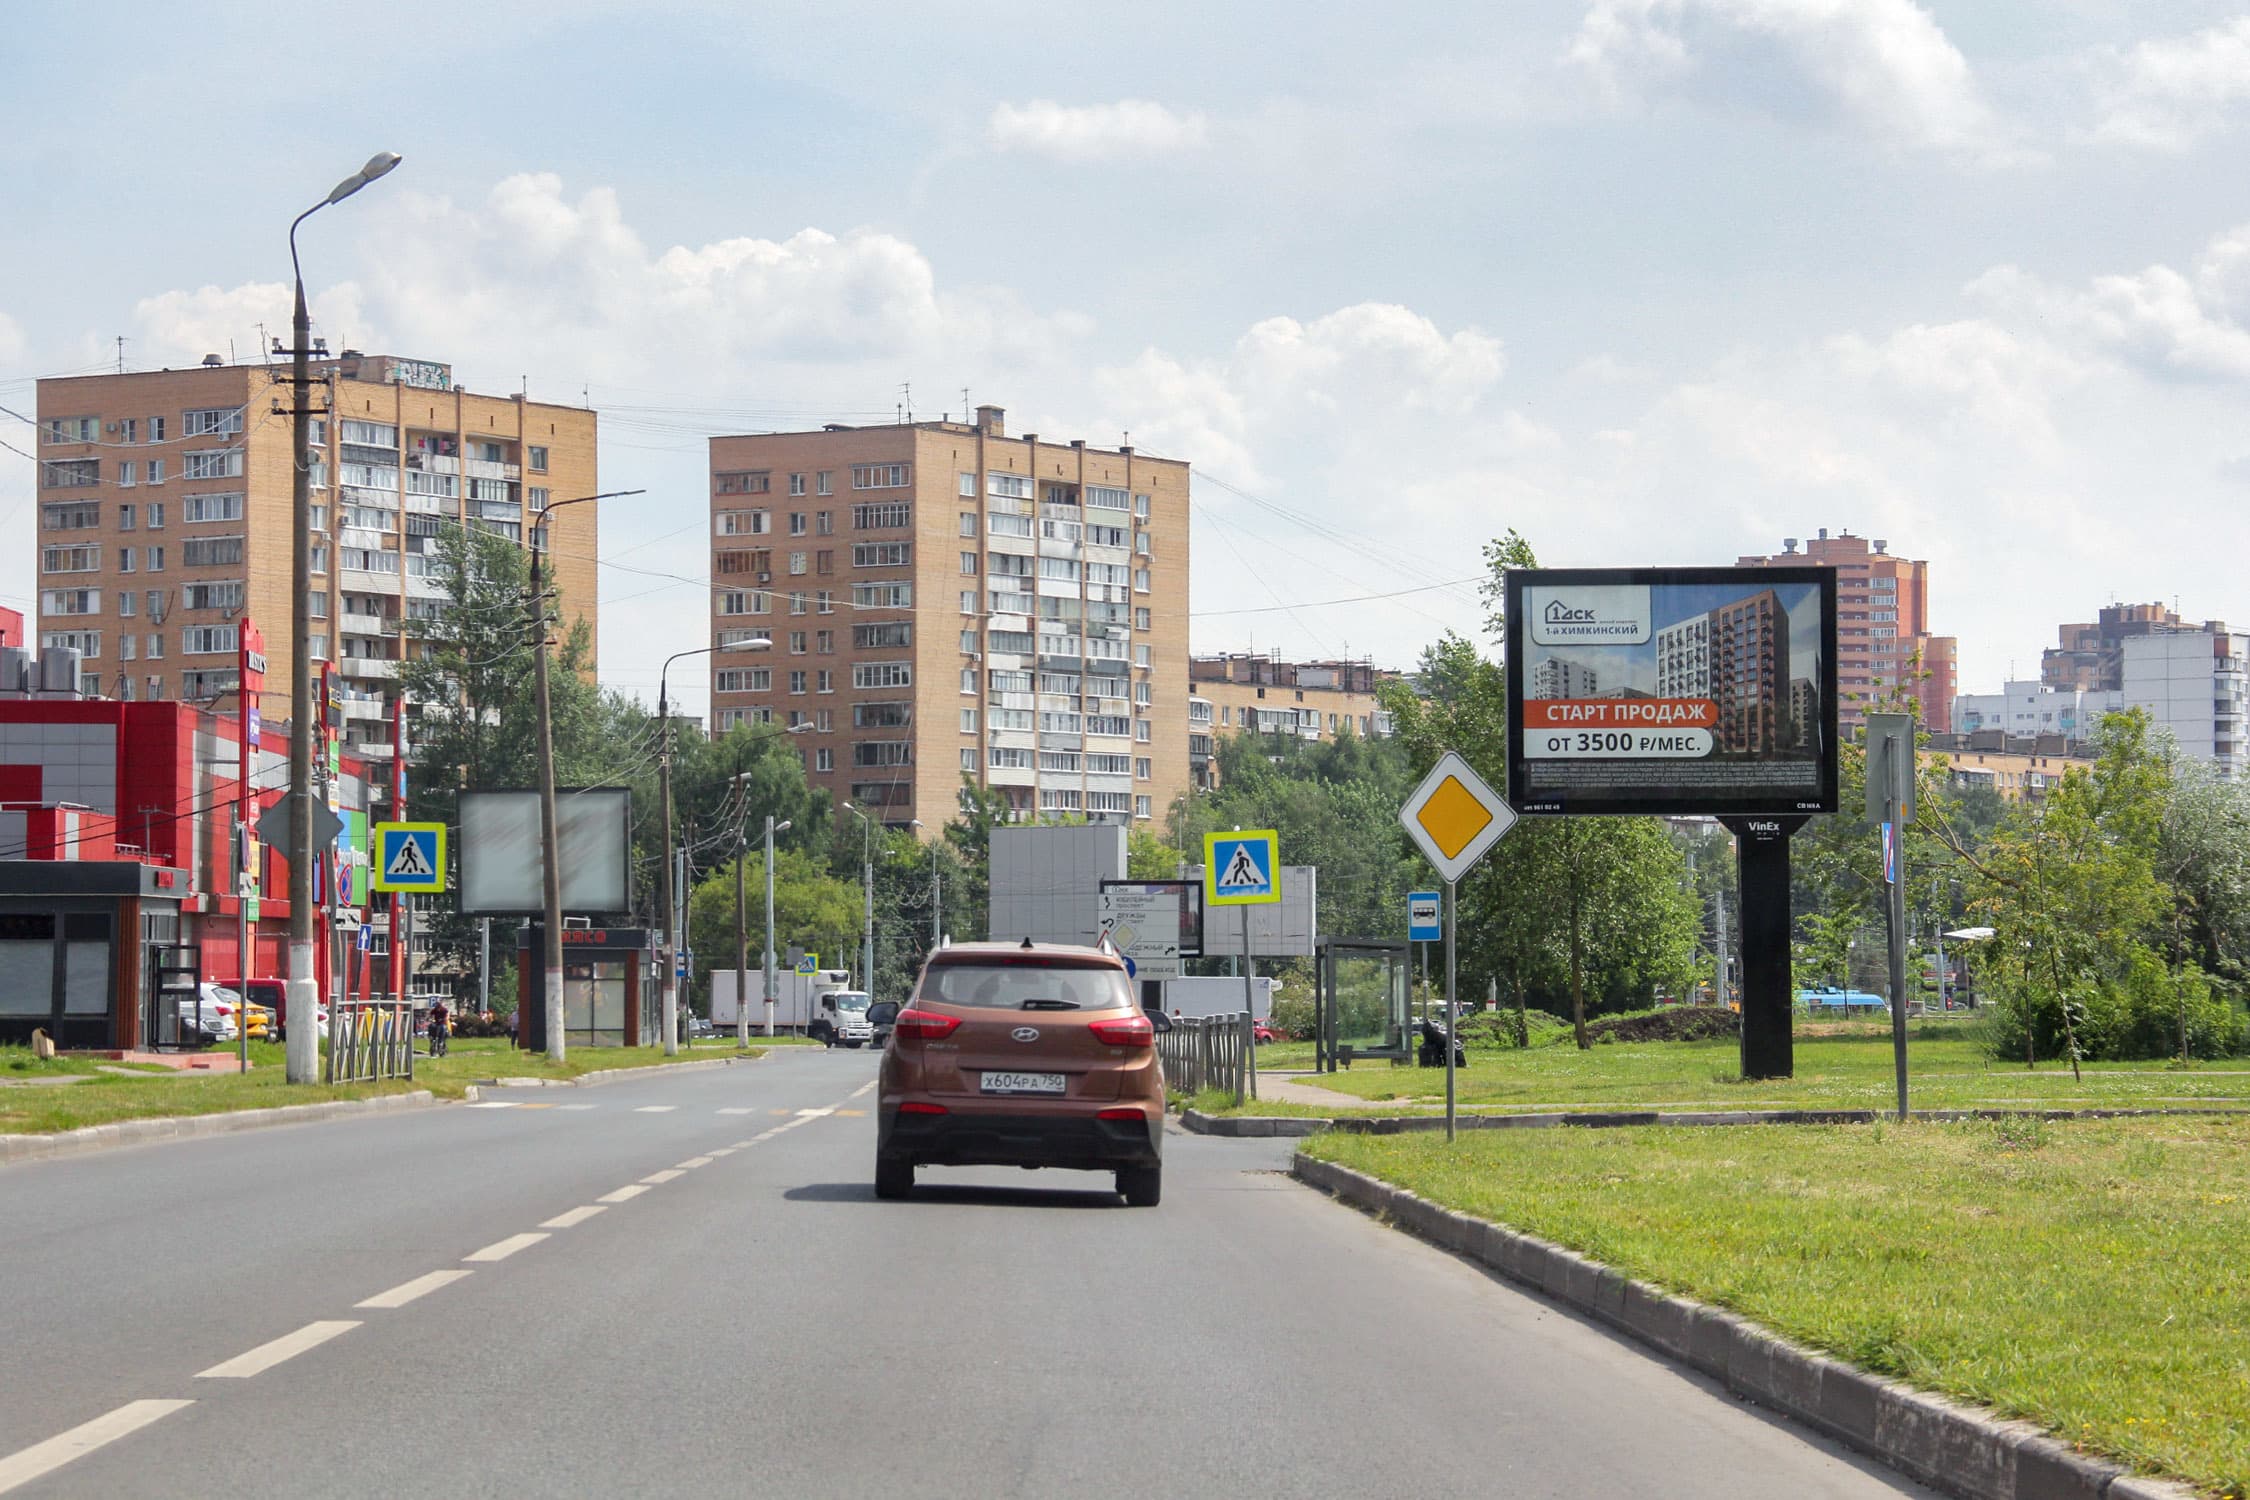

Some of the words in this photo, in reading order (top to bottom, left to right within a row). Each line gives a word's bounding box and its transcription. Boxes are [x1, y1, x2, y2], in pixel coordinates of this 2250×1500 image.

[1560, 625, 1638, 635] ХИМКИНСКИЙ
[1547, 704, 1607, 721] СТАРТ
[1614, 703, 1707, 724] ПРОДАЖ
[1548, 737, 1571, 752] ОТ
[1577, 733, 1633, 752] 3500
[1748, 821, 1780, 832] VinEx
[985, 1074, 1038, 1089] Х604РА
[1041, 1074, 1062, 1086] 750
